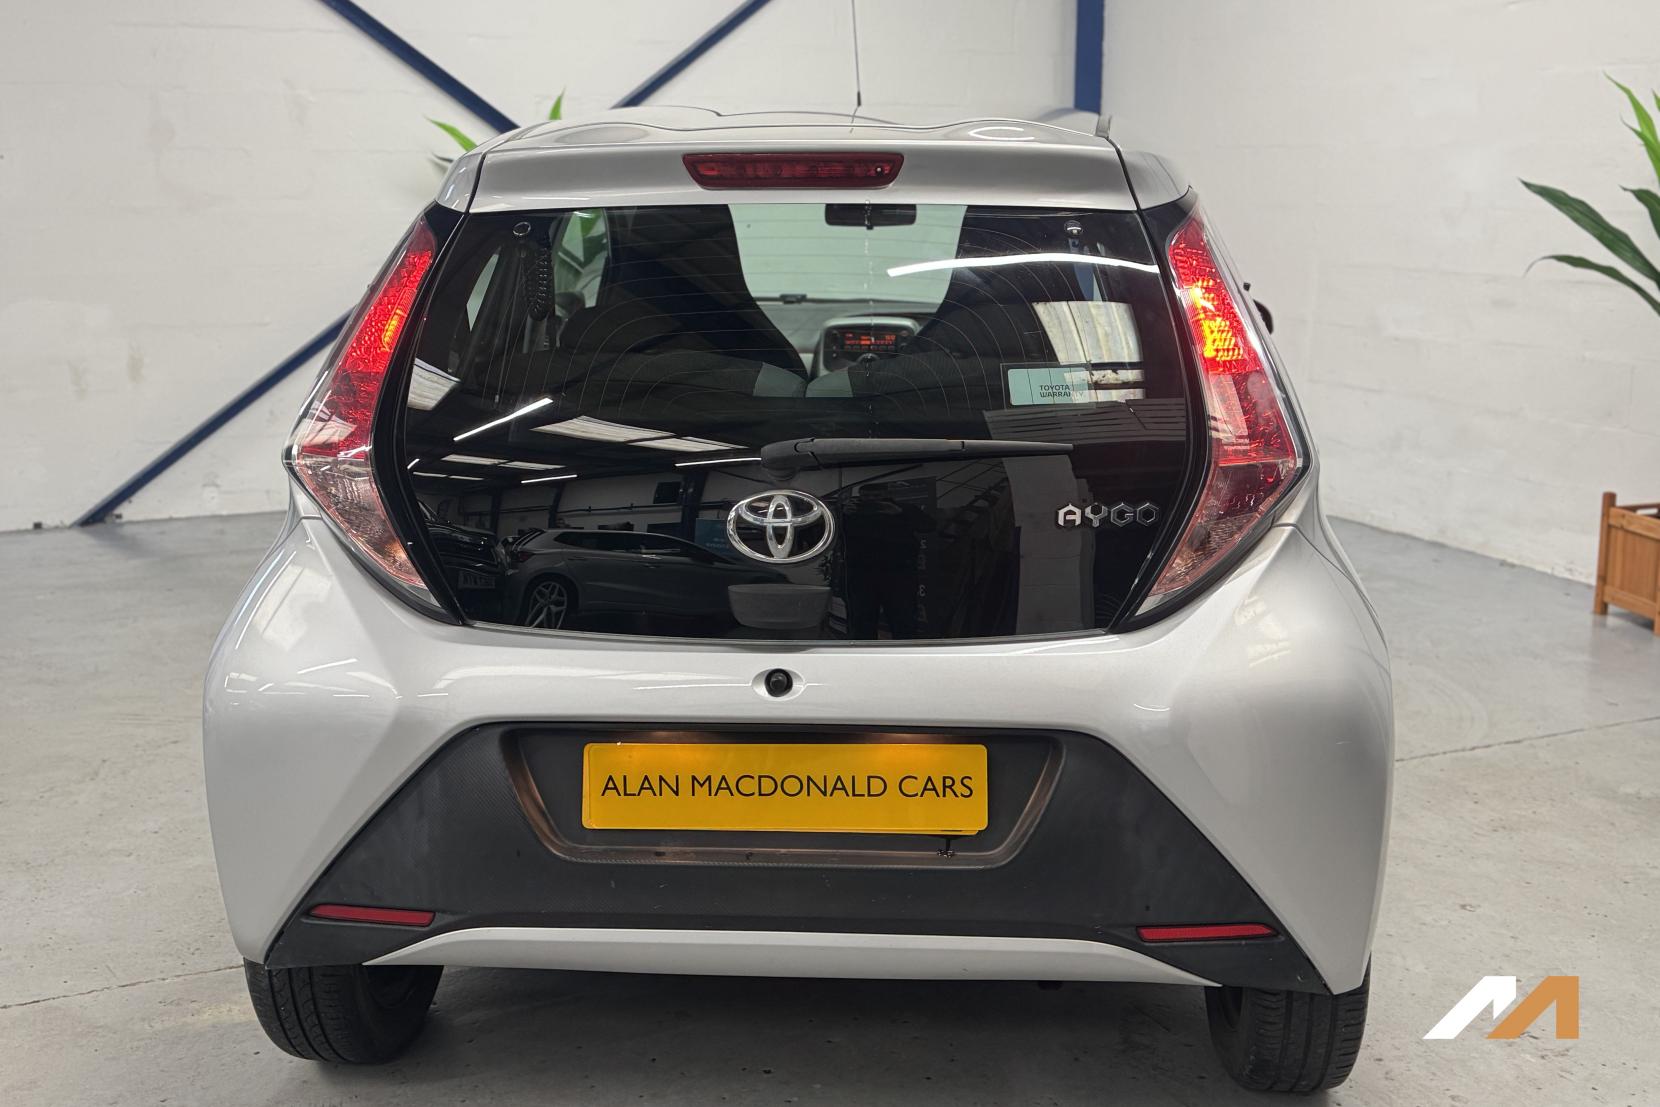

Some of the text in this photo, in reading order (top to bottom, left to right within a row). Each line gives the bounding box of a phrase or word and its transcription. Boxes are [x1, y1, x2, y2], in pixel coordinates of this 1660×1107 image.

[1057, 502, 1160, 528] AYGO
[600, 774, 974, 799] ALAN MACDONALD CARS
